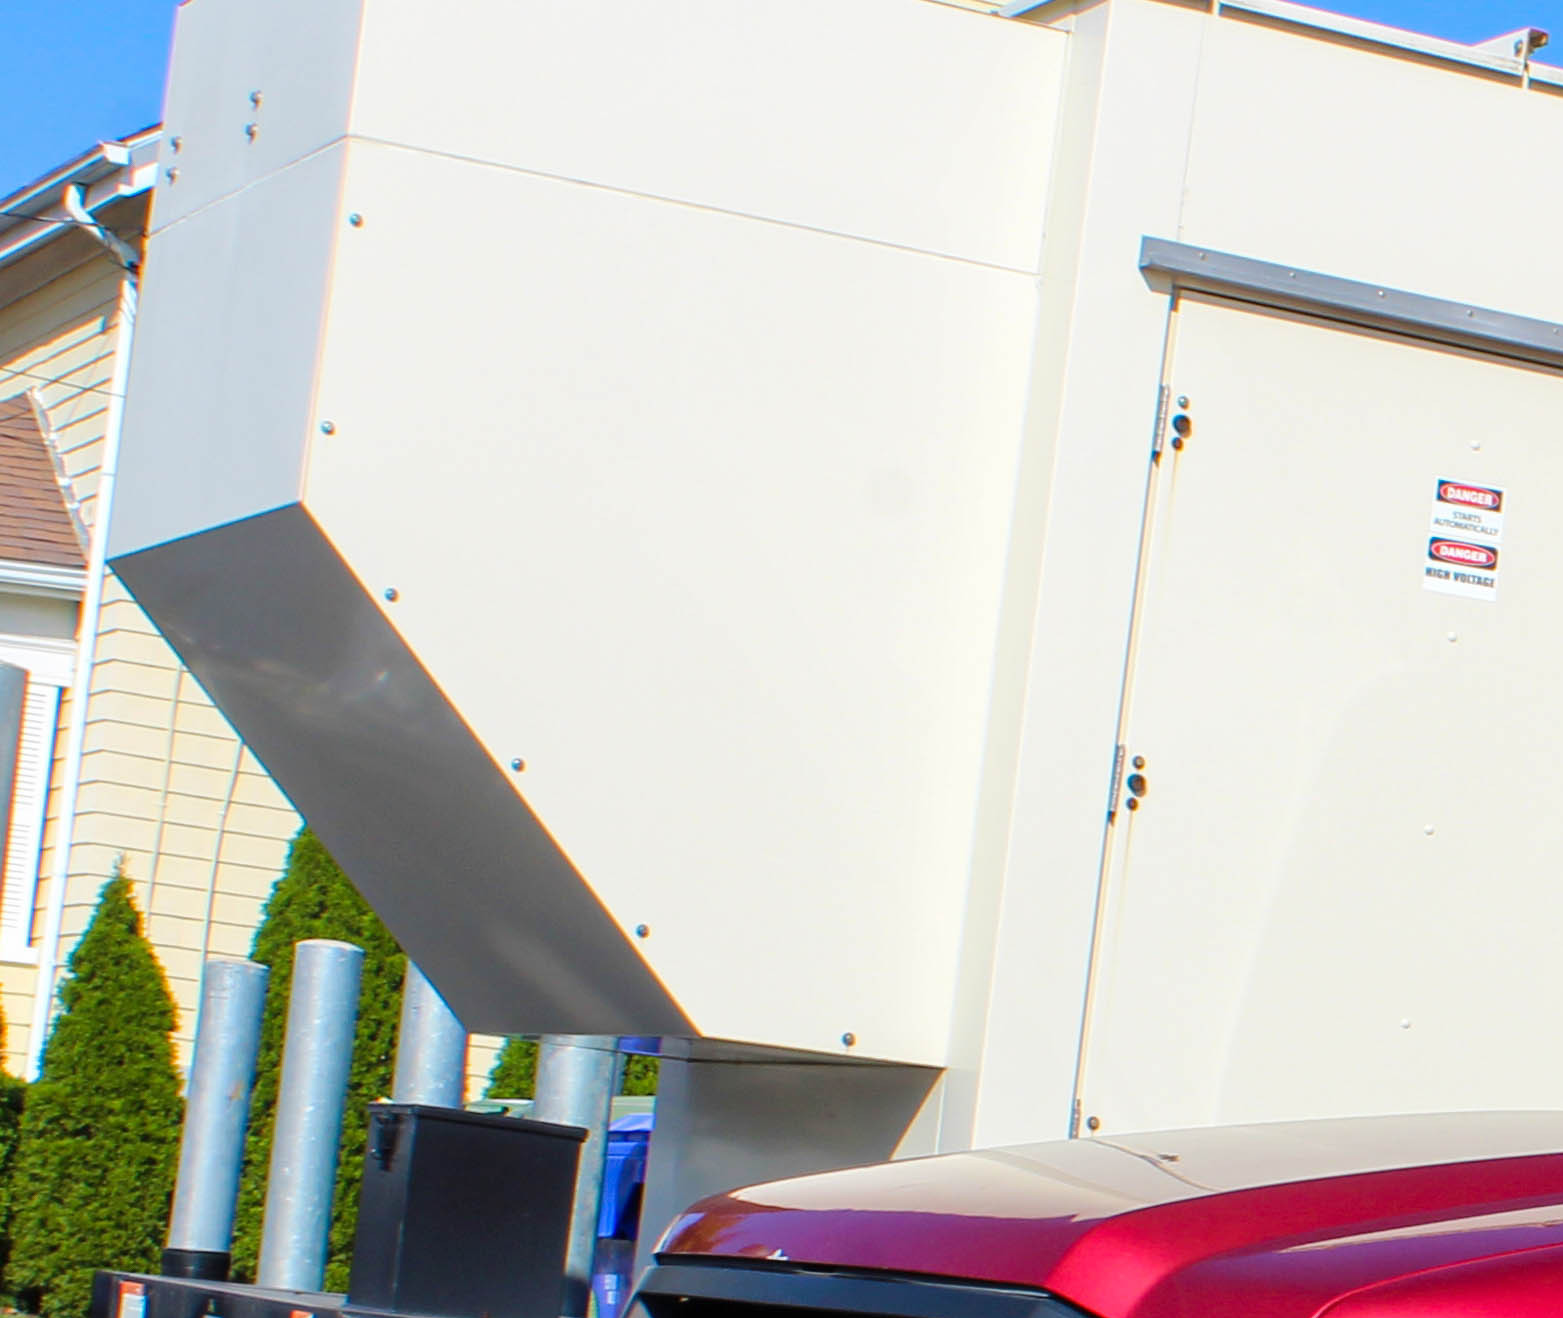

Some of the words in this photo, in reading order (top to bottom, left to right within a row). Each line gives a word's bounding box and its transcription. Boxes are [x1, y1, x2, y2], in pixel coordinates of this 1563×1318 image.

[1447, 486, 1494, 505] DANGER
[1434, 518, 1499, 535] AUTOMATICALLY
[1439, 545, 1489, 562] DANGER
[1425, 567, 1451, 580] HIGH
[1453, 571, 1495, 588] VOLTAGE
